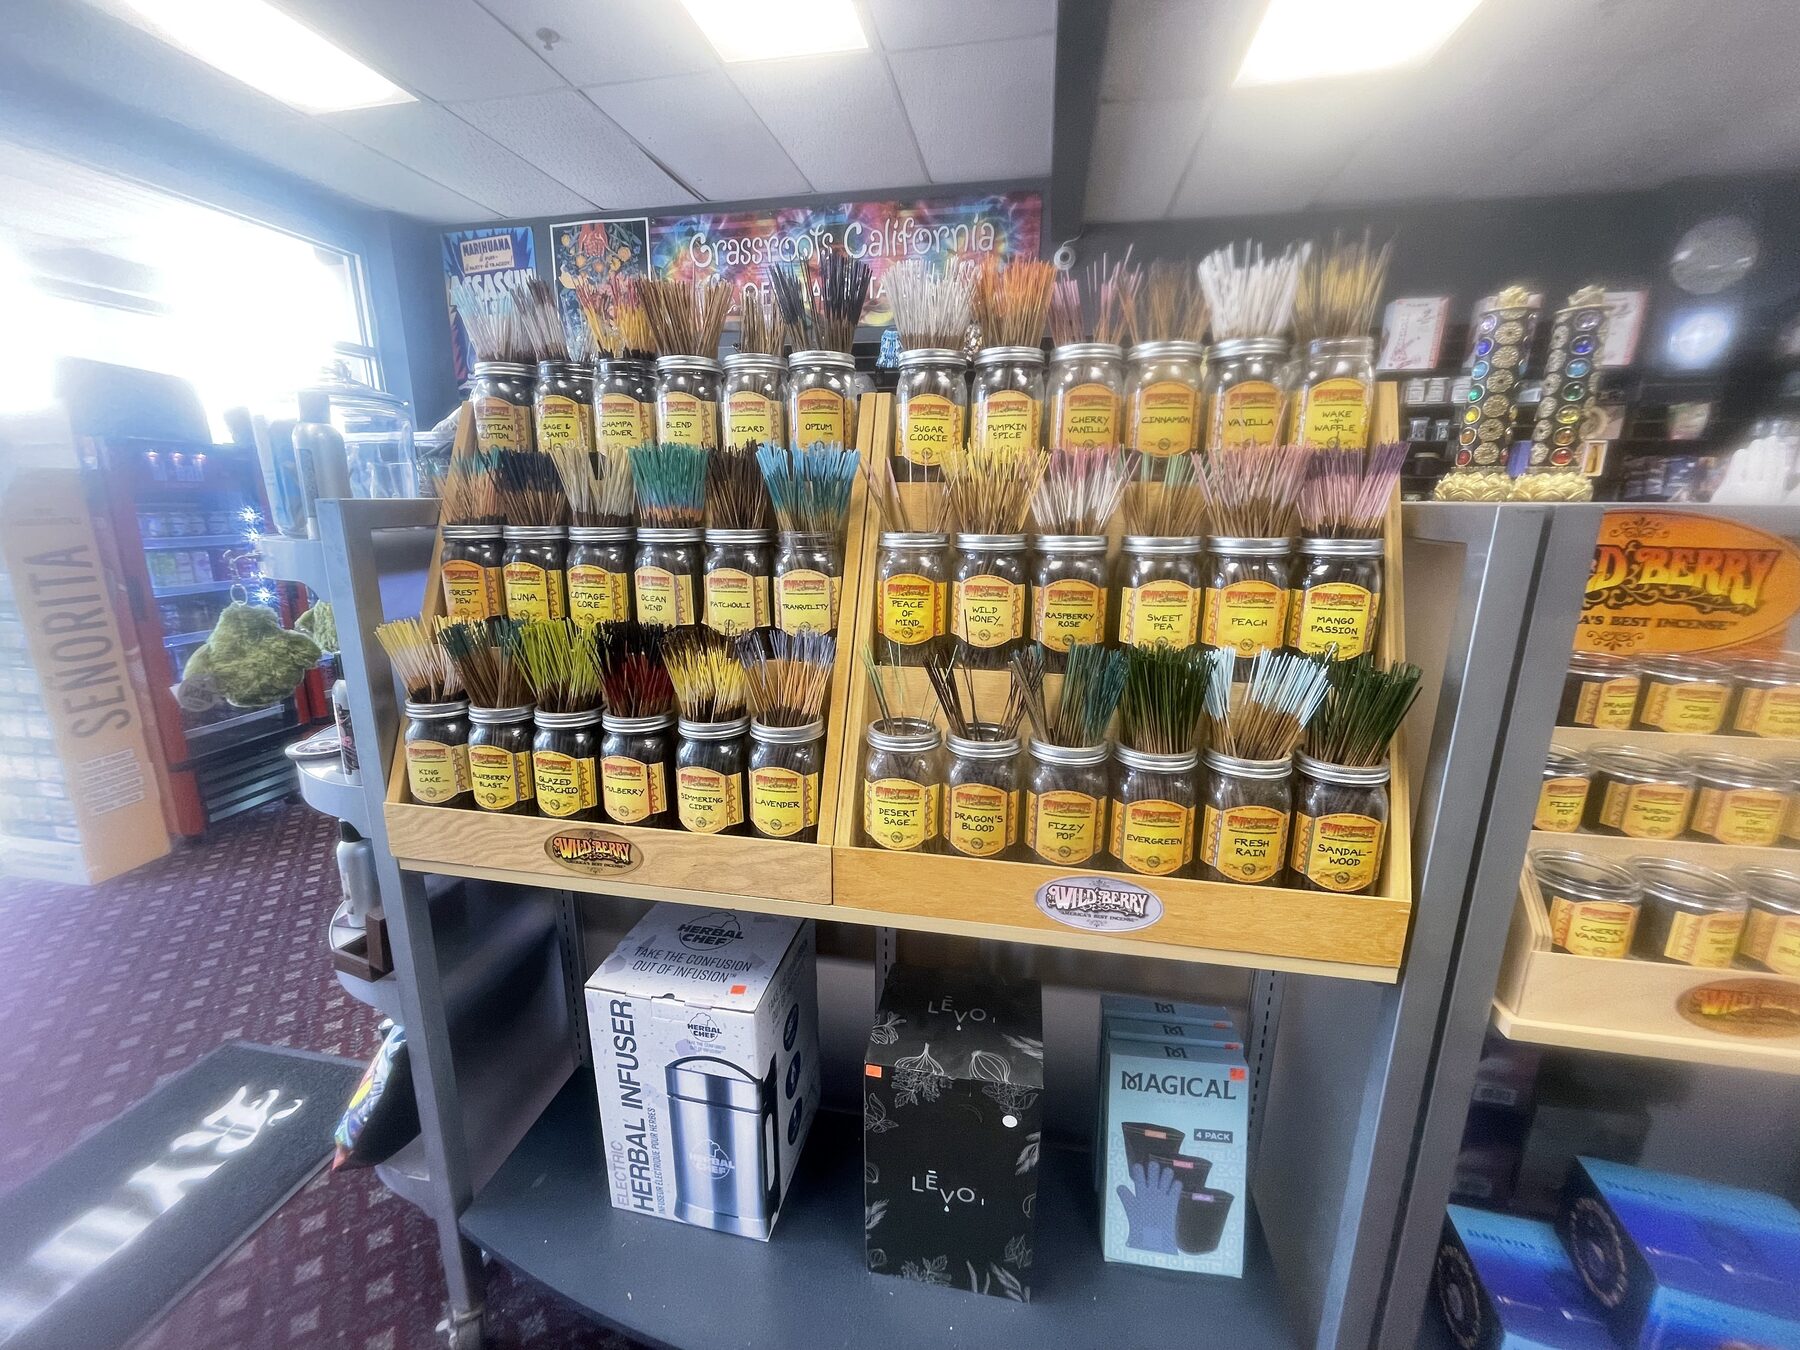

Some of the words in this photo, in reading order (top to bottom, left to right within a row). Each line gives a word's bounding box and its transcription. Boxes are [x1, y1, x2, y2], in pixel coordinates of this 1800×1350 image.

[689, 224, 833, 268] Grassroots
[844, 214, 996, 259] California
[462, 237, 510, 256] MARIHUANA
[1322, 410, 1352, 418] WAKE
[1071, 415, 1110, 424] CHERRY
[1141, 415, 1190, 425] CINNAMON
[731, 425, 765, 433] WIZARD
[805, 423, 832, 431] OPIUM
[913, 424, 943, 433] SUGAR
[987, 423, 1027, 432] PUMPKIN
[1067, 425, 1111, 434] VANILLA
[1314, 424, 1355, 432] WAFFLE
[603, 429, 632, 437] FLOWER
[909, 433, 948, 442] COOKIE
[993, 431, 1021, 439] SPICE
[1634, 546, 1782, 609] BERRY
[449, 589, 479, 597] FOREST
[511, 594, 538, 602] LUNA
[571, 591, 610, 600] COTTAGE-
[641, 595, 667, 603] OCEAN
[577, 601, 600, 609] CORE
[782, 603, 829, 611] TRANQUILITY
[892, 600, 924, 609] PEACE
[972, 606, 998, 614] WILD
[969, 615, 1001, 625] HONEY
[1045, 612, 1095, 621] RASPBERRY
[1146, 613, 1182, 622] SWEET
[1316, 616, 1355, 625] MANGO
[1610, 616, 1651, 627] BEST
[895, 618, 920, 627] MIND
[1058, 620, 1080, 628] ROSE
[1153, 622, 1174, 631] PEA
[1231, 617, 1268, 627] PEACH
[1310, 625, 1358, 635] PASSION
[23, 543, 131, 740] SEÑORITA
[473, 772, 512, 782] BLUEBERRY
[538, 775, 572, 785] GLAZED
[479, 781, 502, 789] BLAST
[536, 783, 578, 794] PISTACHIO
[604, 784, 645, 797] MULBERRY
[680, 792, 724, 804] SIMMERING
[754, 797, 800, 809] LAVENDER
[688, 803, 714, 812] CIDER
[878, 807, 918, 818] DESERT
[883, 817, 911, 826] SAGE
[954, 811, 1003, 824] DRAGON'S
[961, 823, 995, 832] BLOOD
[1047, 821, 1085, 833] FIZZY
[1056, 831, 1076, 840] POP
[1126, 834, 1183, 846] EVERGREEN
[1234, 838, 1270, 848] FRESH
[553, 836, 592, 859] WILD
[592, 840, 632, 862] BERRY
[1235, 847, 1266, 858] RAIN
[1317, 843, 1373, 857] SANDAL-
[1329, 856, 1360, 867] WOOD
[1047, 884, 1097, 910] WILD
[1098, 890, 1149, 917] BERRY
[678, 923, 744, 940] HERBAL
[1580, 925, 1625, 936] CHERRY
[682, 933, 728, 945] CHEF
[634, 946, 664, 960] TAKE
[664, 951, 687, 963] THE
[686, 954, 753, 972] CONFUSION
[632, 960, 658, 972] OUT
[657, 964, 675, 975] OF
[687, 1023, 722, 1034] HERBAL
[609, 999, 644, 1110] INFUSER
[1121, 1070, 1237, 1100] MAGICAL
[647, 1108, 658, 1132] HERBES
[649, 1132, 660, 1150] POUR
[1205, 1132, 1231, 1142] PACK
[624, 1118, 655, 1212] HERBAL
[610, 1139, 629, 1206] ELECTRIC
